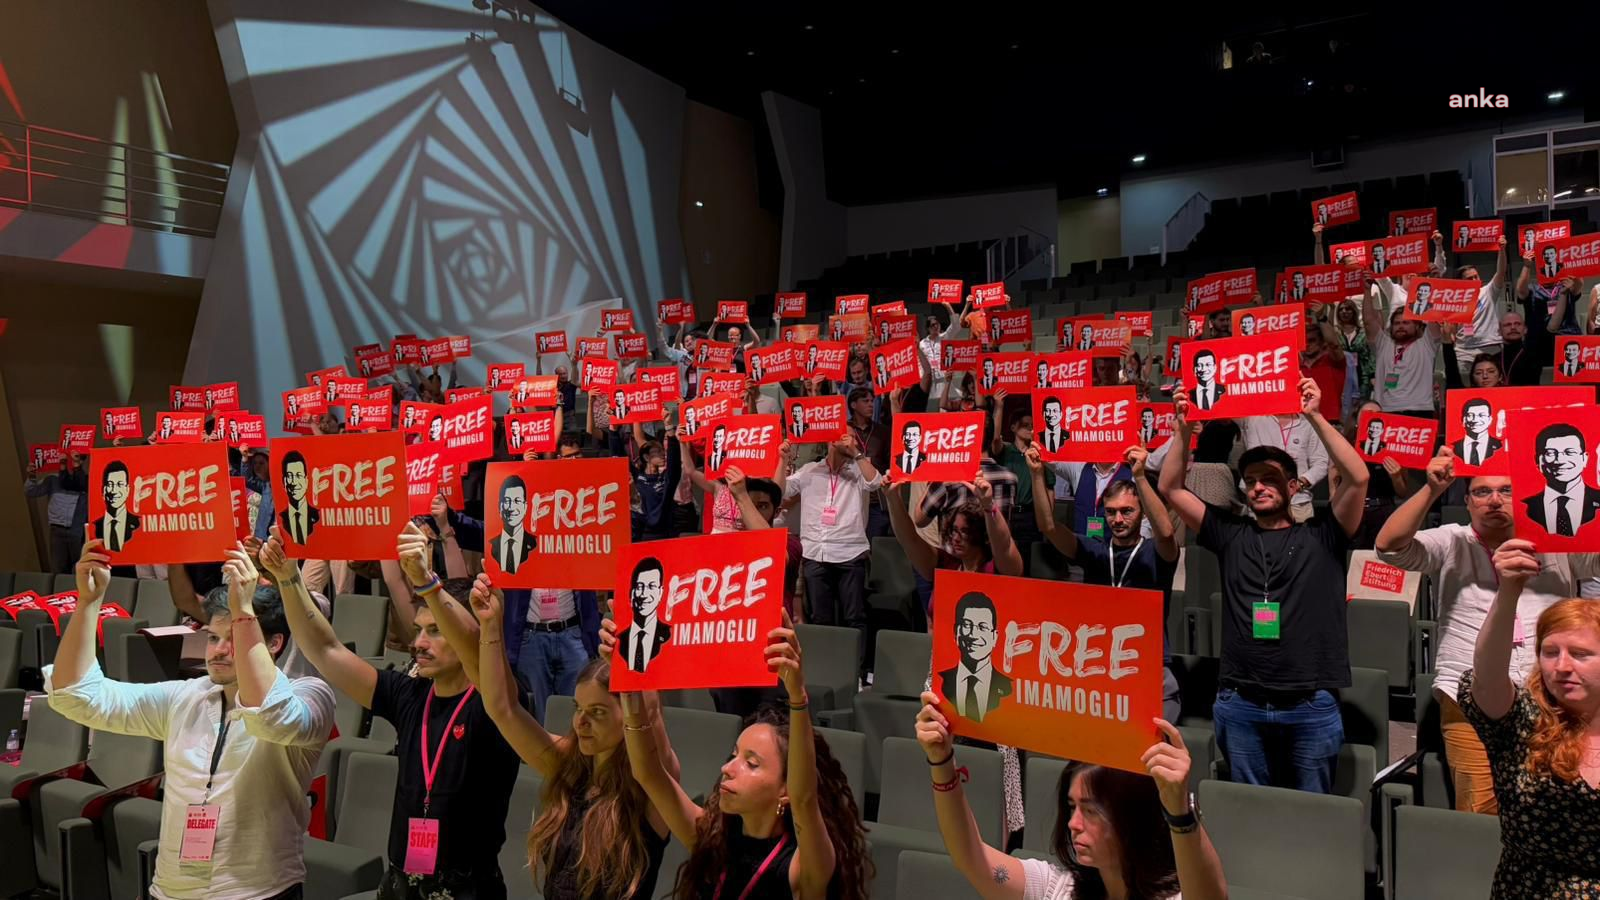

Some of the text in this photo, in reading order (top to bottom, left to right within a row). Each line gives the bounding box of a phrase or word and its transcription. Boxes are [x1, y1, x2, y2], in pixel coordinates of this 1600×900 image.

[1327, 197, 1353, 213] FREE
[1405, 214, 1433, 226] FREE
[1469, 225, 1500, 237] FREE
[1536, 226, 1566, 241] FREE
[1386, 240, 1424, 260] FREE
[1564, 257, 1598, 269] IMAMOGLU
[1224, 275, 1253, 290] FREE
[1305, 270, 1341, 288] FREE
[1199, 280, 1222, 297] FREE
[1431, 288, 1476, 303] FREE
[1433, 303, 1467, 313] IMAMOGLU
[889, 321, 913, 332] FREE
[1001, 315, 1028, 329] FREE
[1256, 312, 1299, 333] FREE
[1094, 327, 1128, 339] FREE
[762, 348, 792, 366] FREE
[816, 350, 846, 362] FREE
[886, 346, 913, 370] FREE
[891, 365, 913, 377] IMAMOGLU
[995, 359, 1030, 376] FREE
[1049, 360, 1087, 380] FREE
[1220, 346, 1290, 383] FREE
[212, 387, 234, 400] FREE
[526, 380, 557, 392] FREE
[713, 379, 741, 392] FREE
[1227, 379, 1285, 396] IMAMOGLU
[297, 390, 321, 405] FREE
[626, 388, 659, 405] FREE
[113, 412, 137, 424] FREE
[697, 400, 728, 422] FREE
[805, 403, 842, 422] FREE
[1065, 400, 1129, 430] FREE
[172, 418, 201, 430] FREE
[238, 421, 262, 433] FREE
[443, 407, 487, 438] FREE
[521, 418, 551, 435] FREE
[448, 432, 484, 448] IMAMOGLU
[725, 425, 774, 450] FREE
[923, 424, 978, 451] FREE
[1072, 429, 1123, 442] IMAMOGLU
[1384, 426, 1432, 444] FREE
[727, 449, 765, 460] IMAMOGLU
[1386, 442, 1424, 456] IMAMOGLU
[927, 451, 970, 464] IMAMOGLU
[406, 453, 439, 482] REE
[133, 464, 219, 513] FREE
[312, 456, 395, 505] FREE
[408, 482, 430, 495] AMOGLU
[530, 482, 619, 532] FREE
[143, 512, 214, 532] IMAMOGLU
[322, 507, 390, 526] IMAMOGLU
[539, 534, 611, 554] IMAMOGLU
[1366, 570, 1387, 580] Ebert
[1367, 563, 1402, 576] Friedrich
[665, 556, 773, 621] FREE
[1363, 577, 1396, 590] Stiftung
[673, 619, 757, 646] IMAMOGLU
[1003, 620, 1145, 680] FREE
[1015, 678, 1129, 722] IMAMOGLU
[410, 832, 437, 848] STAFF
